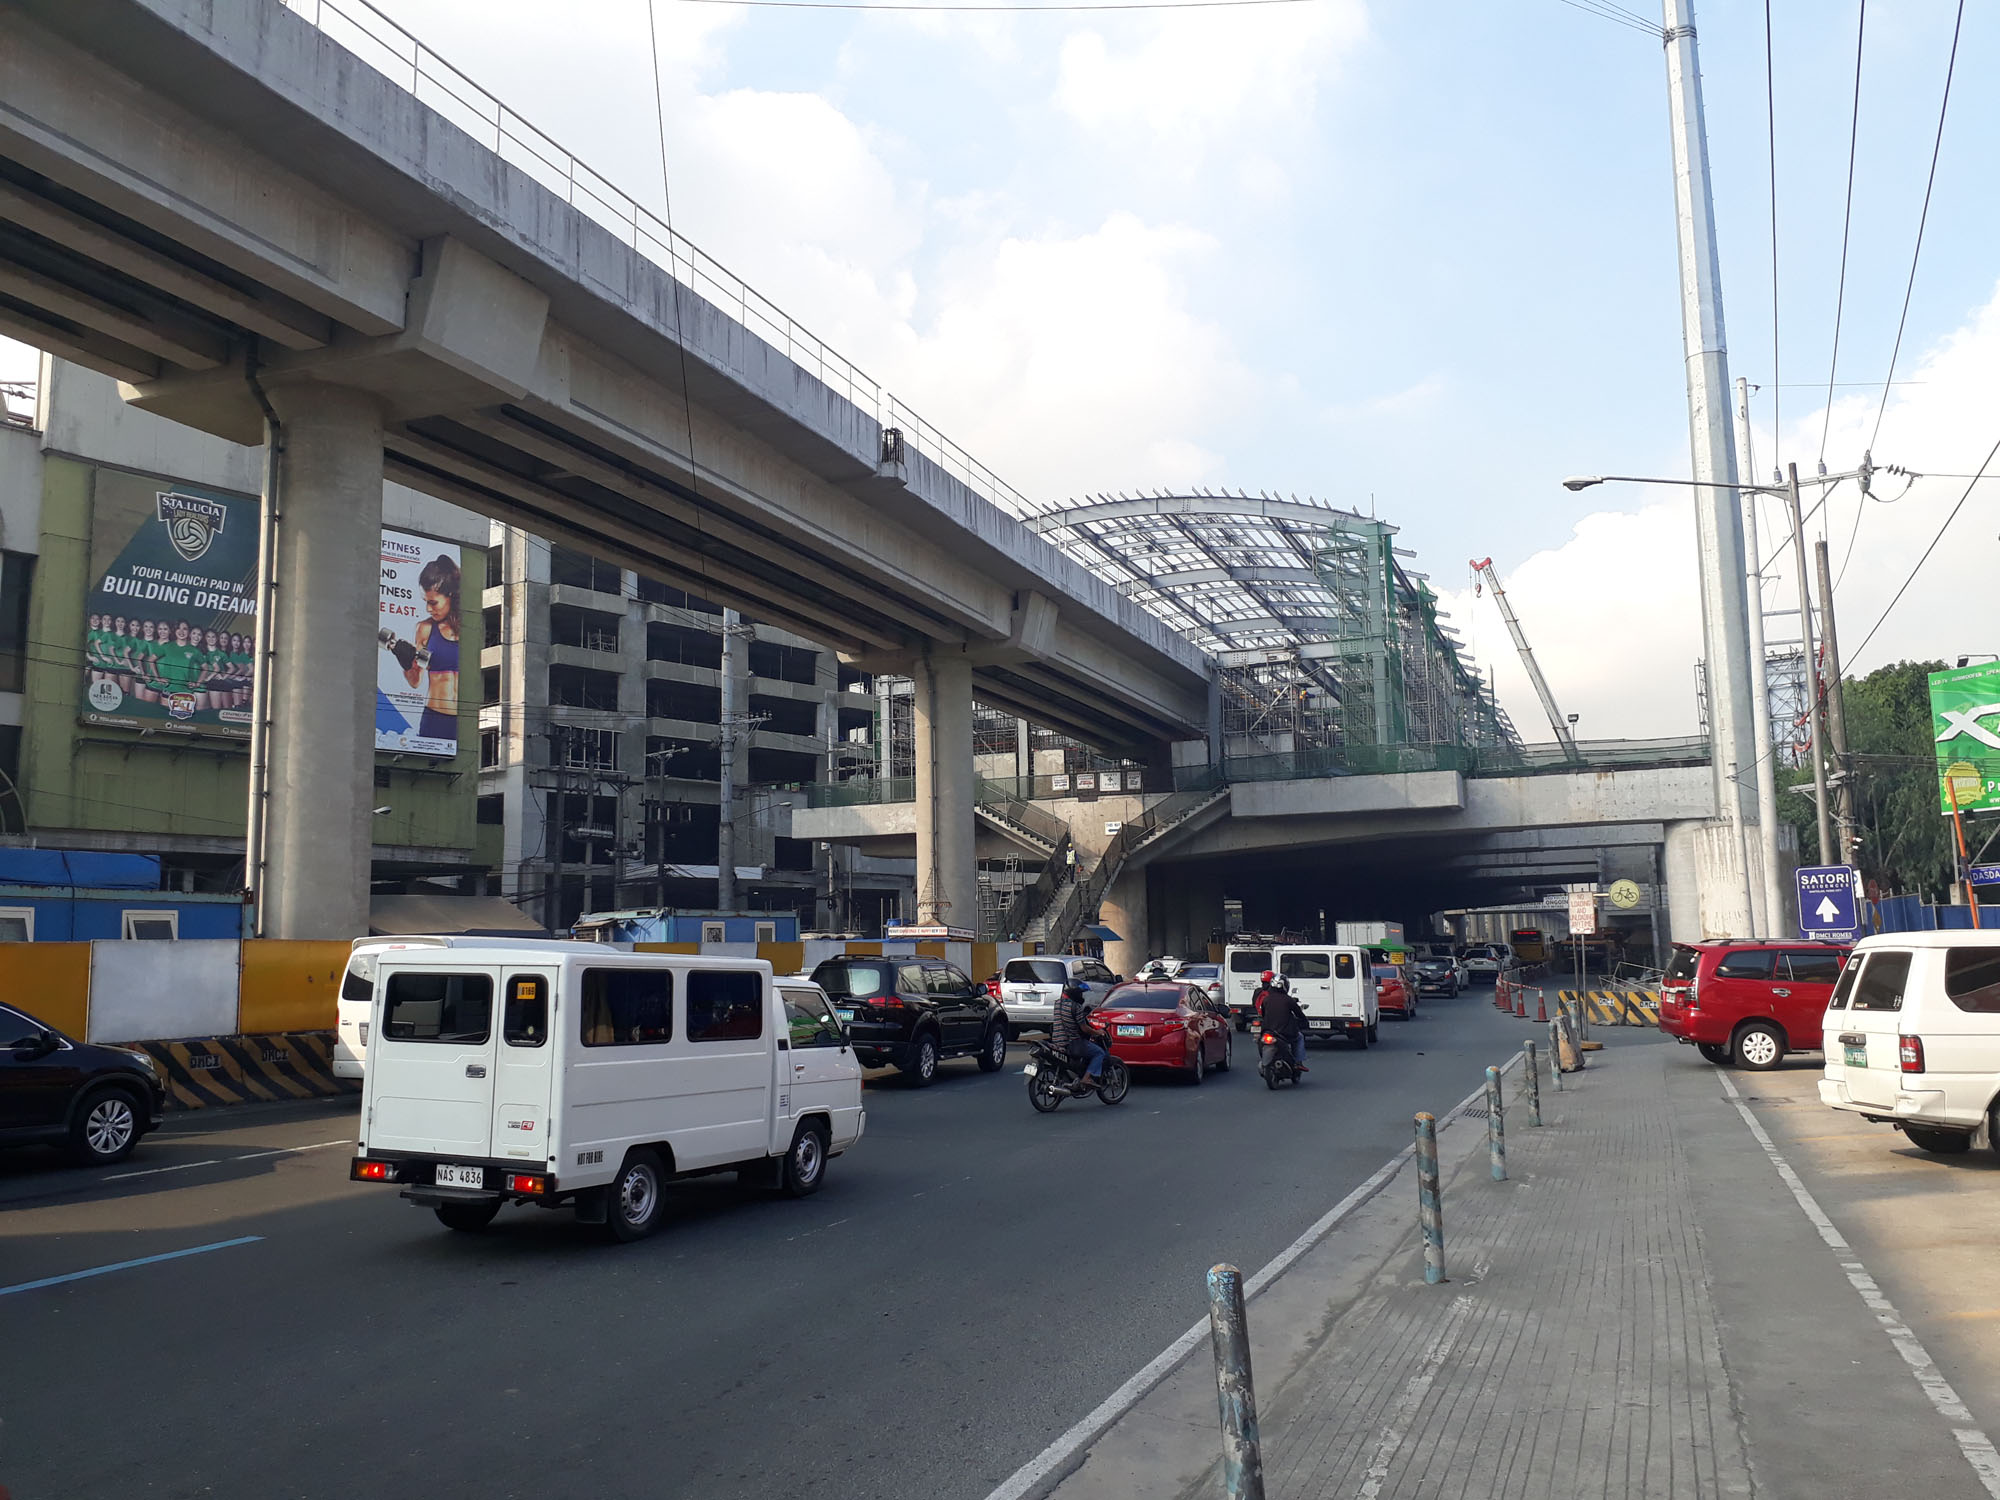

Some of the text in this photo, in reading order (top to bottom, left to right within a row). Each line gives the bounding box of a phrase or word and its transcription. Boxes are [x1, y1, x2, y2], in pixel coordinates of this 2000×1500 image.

[381, 540, 421, 555] FITNESS
[132, 564, 244, 594] YOUR LAUNCH PAD IN
[380, 568, 398, 579] ND
[102, 575, 190, 605] BUILDING
[389, 603, 420, 618] EAST.
[1800, 873, 1850, 885] SATORI
[437, 1168, 482, 1184] NAS 4836
